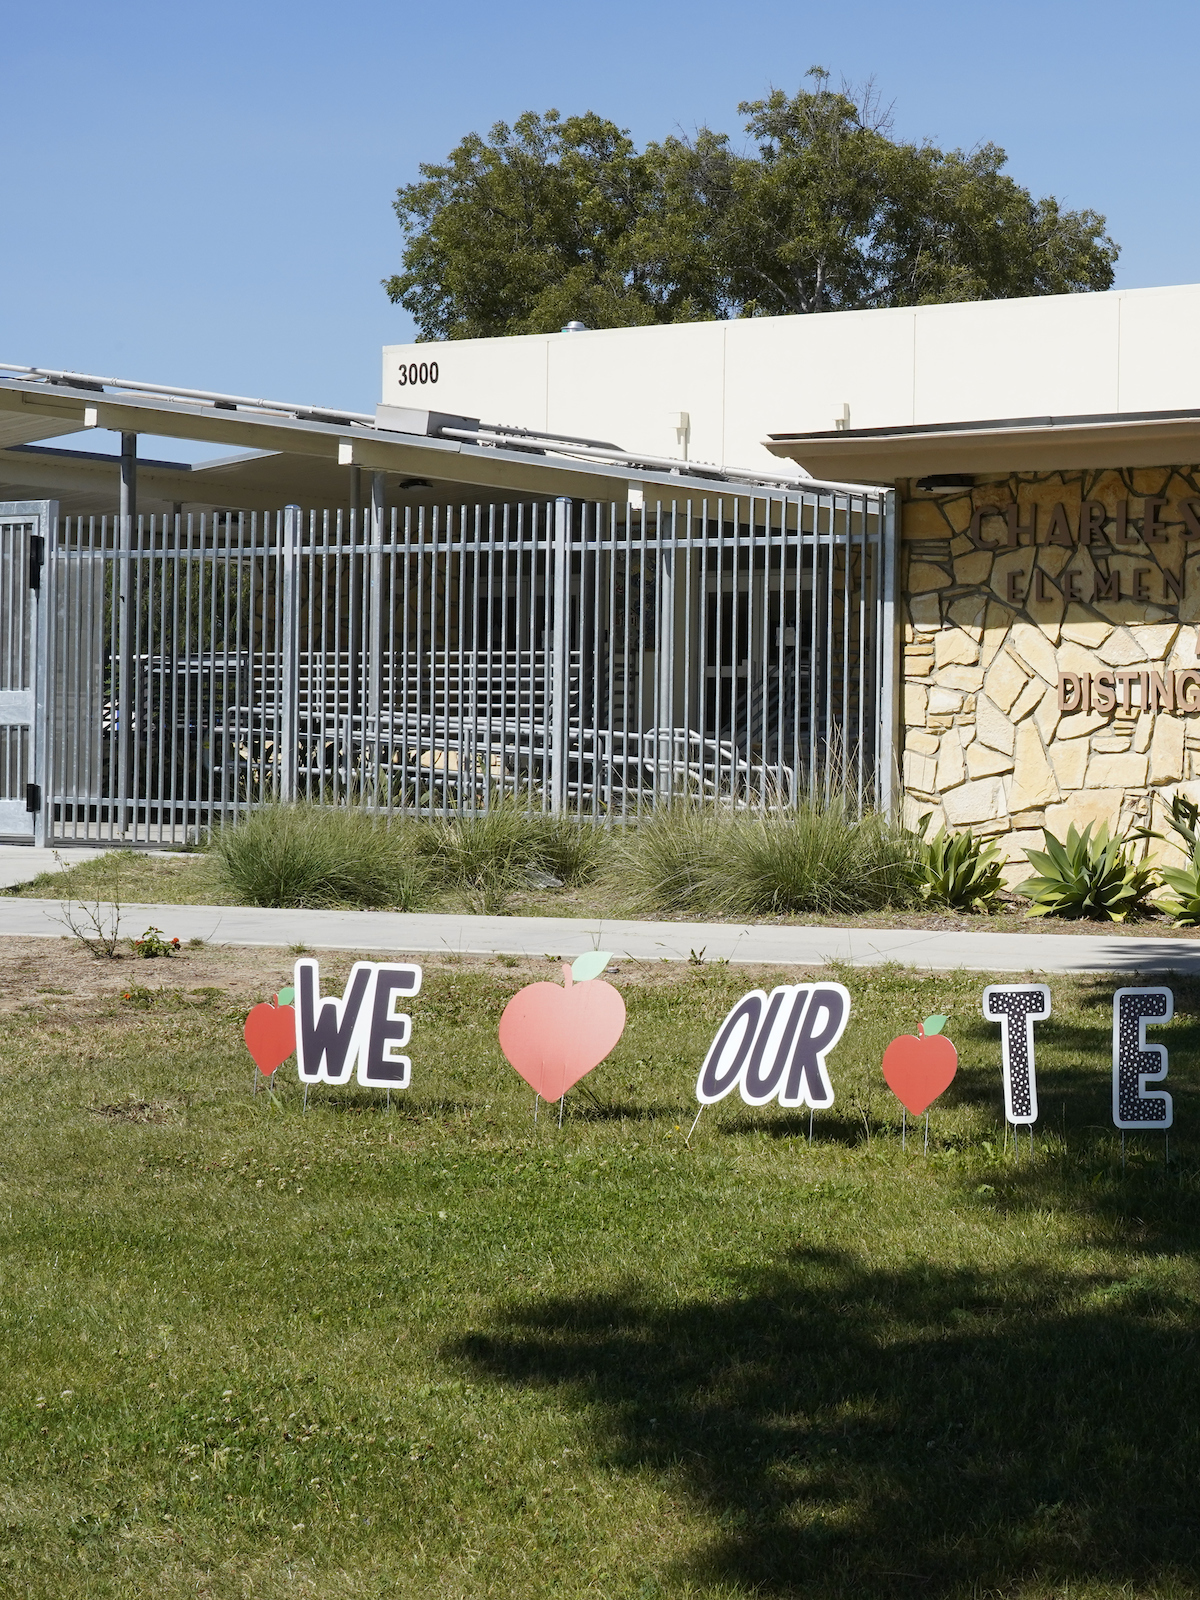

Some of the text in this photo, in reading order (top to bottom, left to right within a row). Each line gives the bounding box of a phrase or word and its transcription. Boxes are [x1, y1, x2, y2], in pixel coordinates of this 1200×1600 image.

[398, 361, 439, 386] 3000
[297, 960, 420, 1086] WE
[699, 984, 849, 1106] OUR
